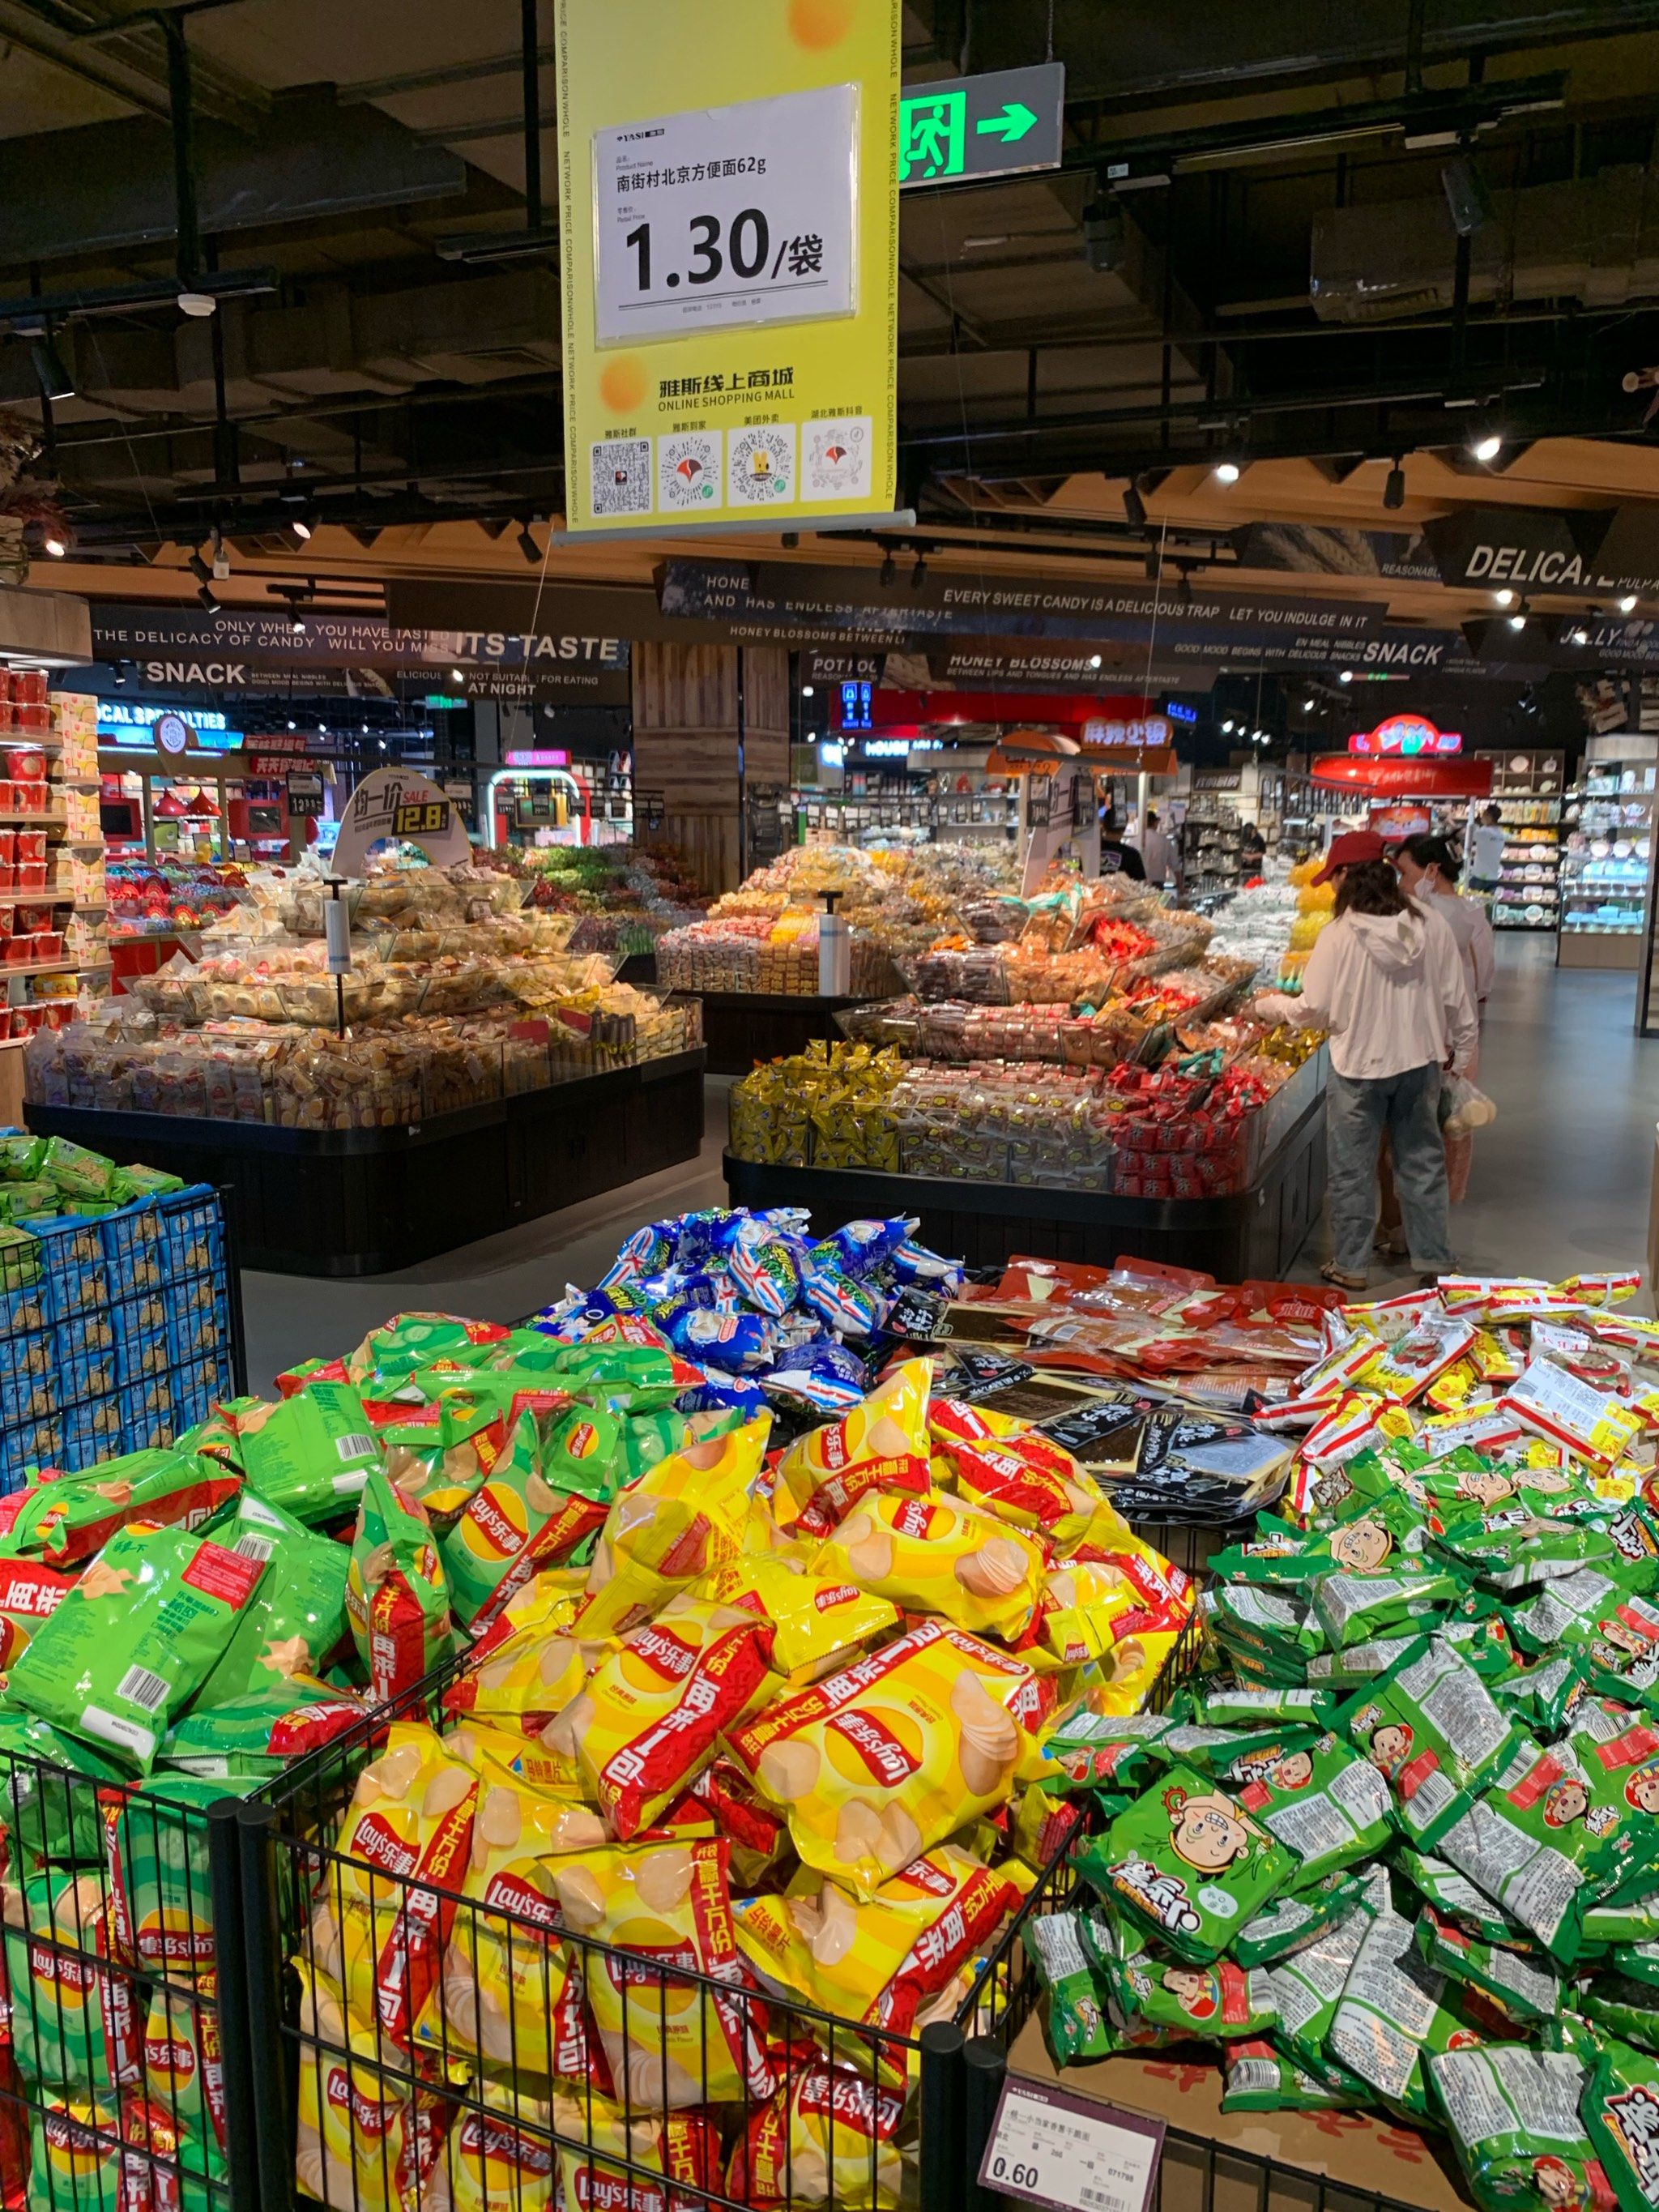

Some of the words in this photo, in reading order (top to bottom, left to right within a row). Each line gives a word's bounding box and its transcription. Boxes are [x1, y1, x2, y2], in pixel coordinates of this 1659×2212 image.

[617, 156, 766, 193] 南街村北京方便面62g
[659, 366, 794, 398] 雅斯线上商城
[658, 399, 699, 412] ONLINE
[702, 393, 761, 408] SHOPPING
[765, 388, 795, 400] MALL
[744, 414, 779, 426] 美团外卖
[704, 595, 736, 607] AND
[944, 590, 988, 604] EVERY
[992, 592, 1040, 606] SWEET
[1043, 596, 1088, 611] CANDY
[1091, 599, 1104, 612] IS
[1107, 598, 1117, 611] A
[1118, 600, 1183, 617] DELICIOUS
[1188, 604, 1220, 618] TRAP
[1230, 608, 1252, 621] LET
[1257, 609, 1282, 624] YOU
[1284, 612, 1337, 626] INDULGE
[1340, 615, 1352, 627] IN
[1355, 616, 1368, 628] IT
[215, 621, 255, 633] ONLY
[315, 625, 347, 636] YOU
[352, 626, 390, 638] HAVE
[730, 626, 771, 637] HONEY
[774, 628, 837, 641] BLOSSOMS
[839, 631, 892, 643] BETWEEN
[93, 630, 128, 642] THE
[135, 631, 223, 645] DELICACY
[229, 634, 250, 646] OF
[258, 635, 315, 648] CANDY
[328, 638, 366, 650] WILL
[372, 641, 405, 652] YOU
[519, 634, 620, 661] TASTE
[813, 658, 845, 672] POT
[1363, 643, 1444, 665] SNACK
[147, 662, 245, 684] SNACK
[469, 673, 490, 681] NOT
[541, 675, 561, 685] FOR
[564, 676, 599, 686] EATING
[468, 683, 487, 694] AT
[490, 684, 536, 695] NIGHT
[403, 790, 429, 804] SALE
[397, 805, 441, 833] 12.8
[1110, 1860, 1201, 1935] 小当家
[992, 2156, 1039, 2189] 0.60
